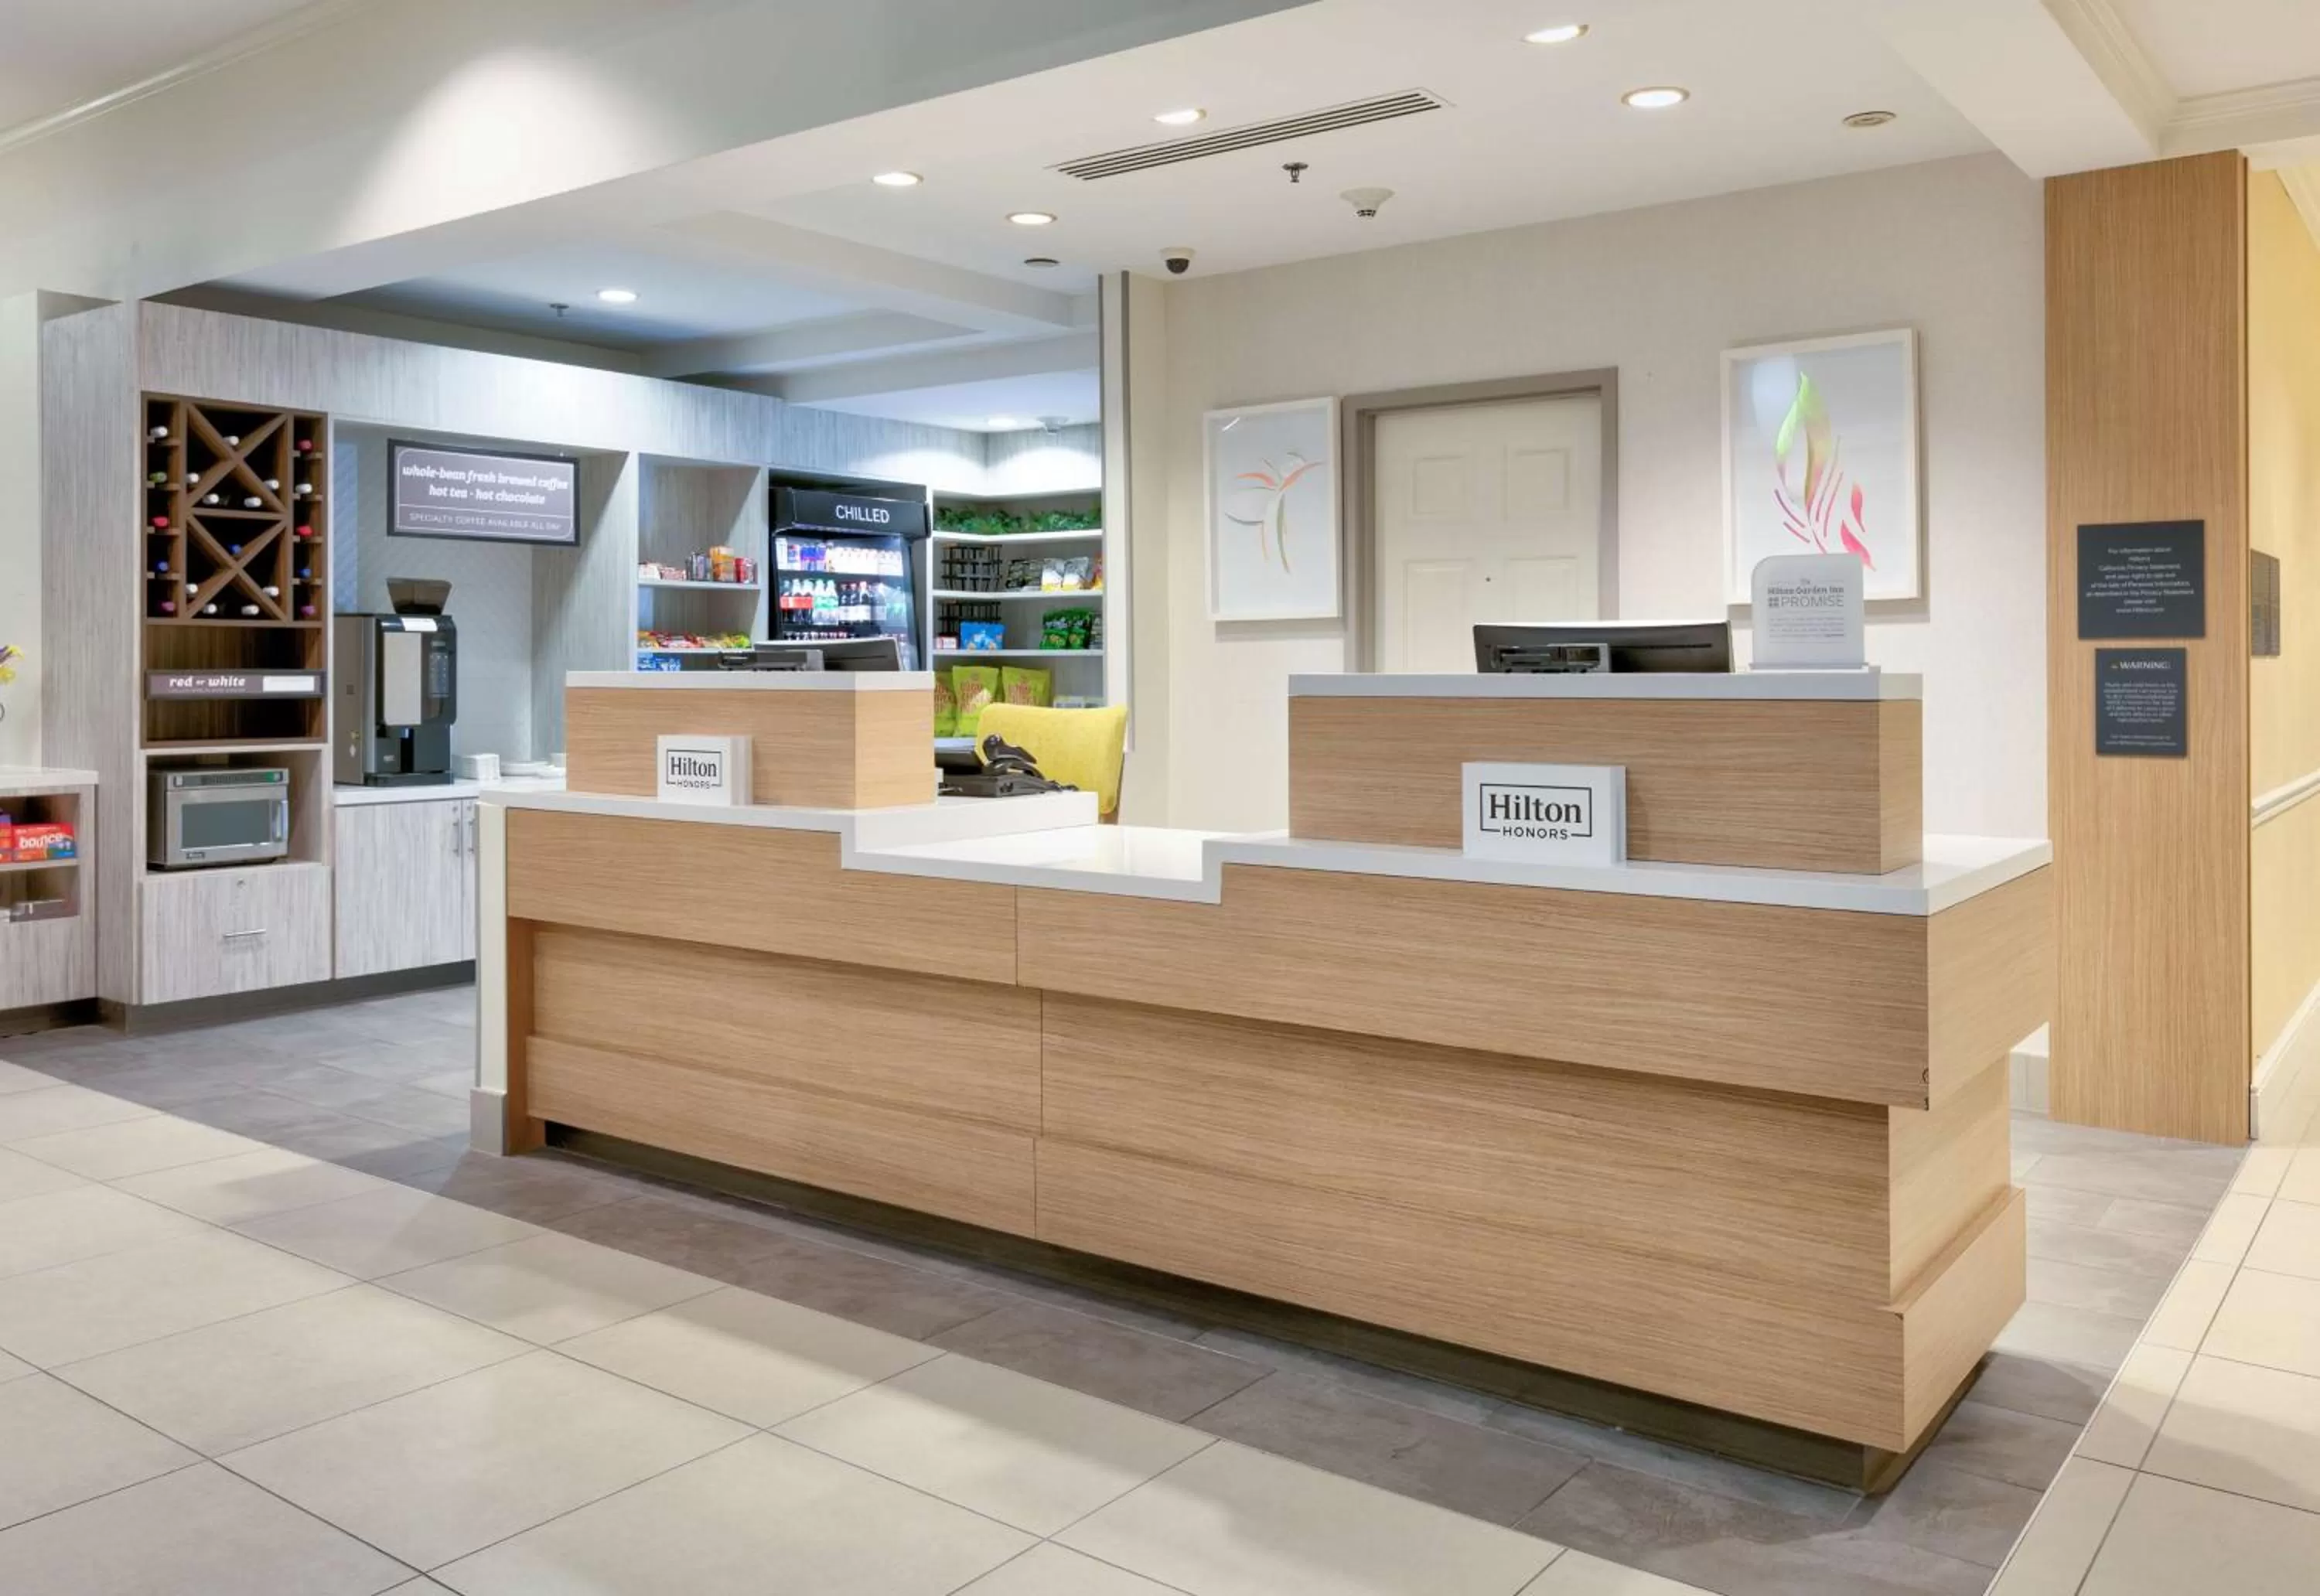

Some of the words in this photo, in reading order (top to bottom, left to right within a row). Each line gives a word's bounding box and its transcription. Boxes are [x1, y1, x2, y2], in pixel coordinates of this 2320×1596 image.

[401, 464, 466, 480] whole-bean
[465, 469, 496, 484] fresh
[537, 476, 569, 491] coffee
[429, 483, 448, 496] hot
[449, 486, 469, 499] tea
[475, 488, 493, 500] hot
[495, 489, 545, 504] chocolate
[835, 504, 890, 524] CHILLED
[1796, 585, 1827, 595] Garden
[1829, 585, 1844, 595] Inn
[1781, 595, 1844, 607] PROMISE
[169, 675, 193, 687] red
[207, 676, 246, 687] white
[670, 756, 718, 777] Hilton
[677, 779, 711, 789] HONORS
[1489, 793, 1583, 824] Hilton
[1503, 826, 1569, 841] HONORS
